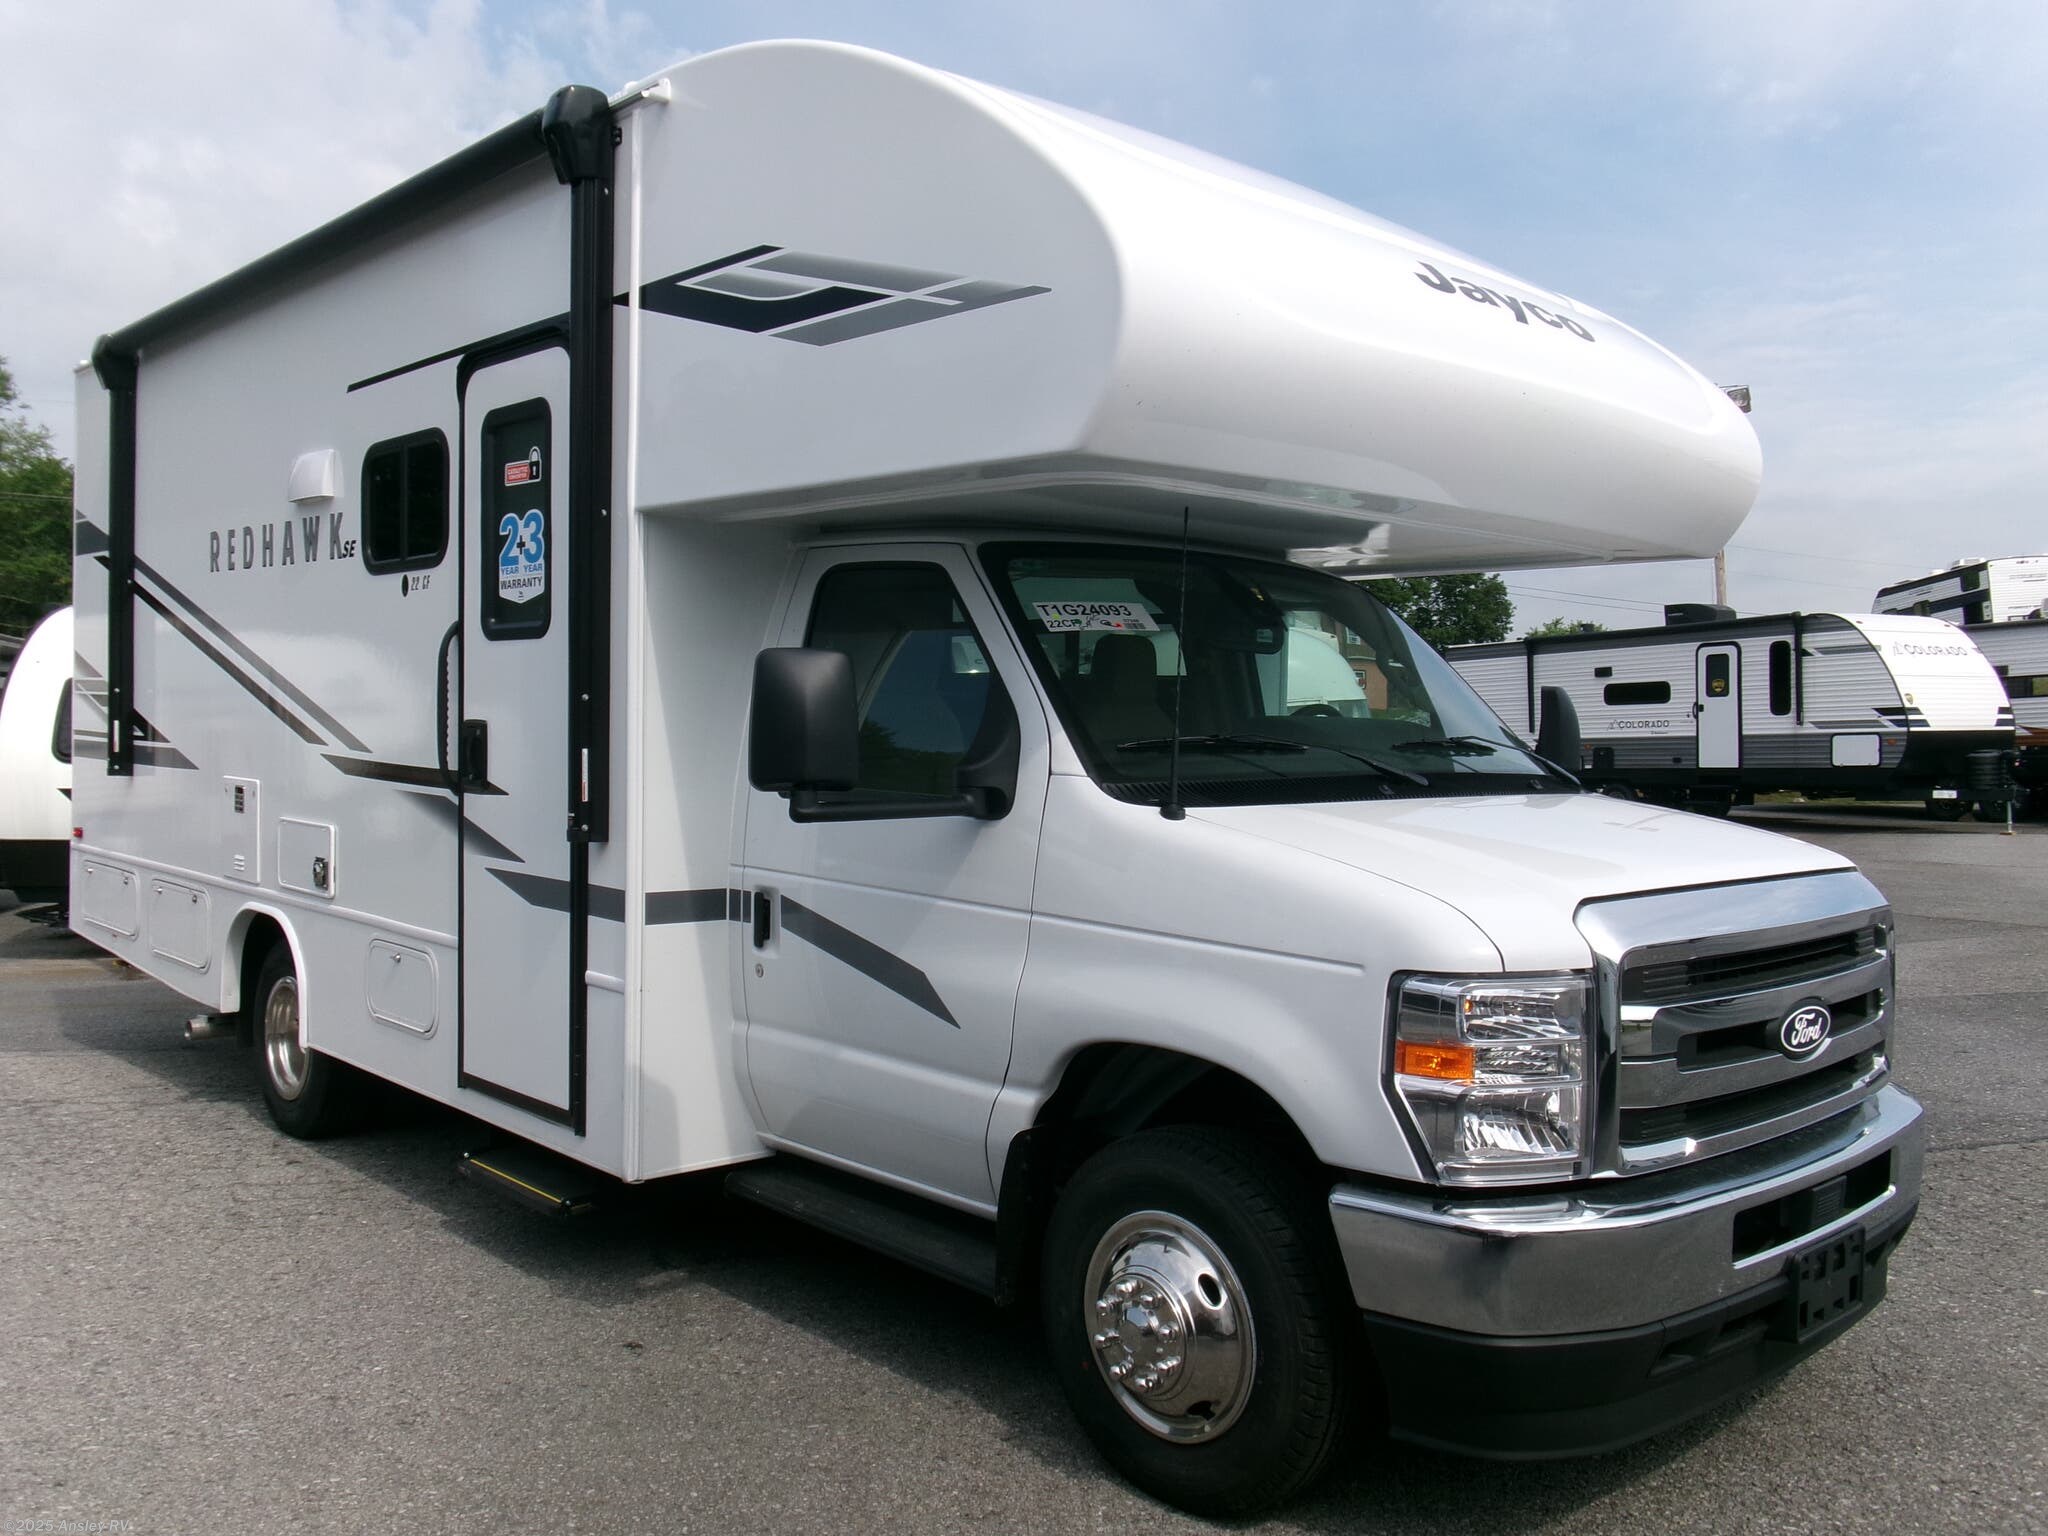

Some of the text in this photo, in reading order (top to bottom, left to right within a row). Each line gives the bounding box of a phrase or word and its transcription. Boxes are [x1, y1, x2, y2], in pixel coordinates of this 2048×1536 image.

[1413, 260, 1596, 342] Jayco
[210, 512, 357, 573] REDHAWK SE
[501, 563, 543, 575] YEAR YEAR
[411, 576, 420, 591] 22
[500, 576, 543, 590] WARRANTY
[1036, 604, 1132, 617] T1G24093
[1903, 644, 1968, 656] COLORADO
[1618, 720, 1670, 729] COLORADO
[1791, 1012, 1823, 1046] Ford
